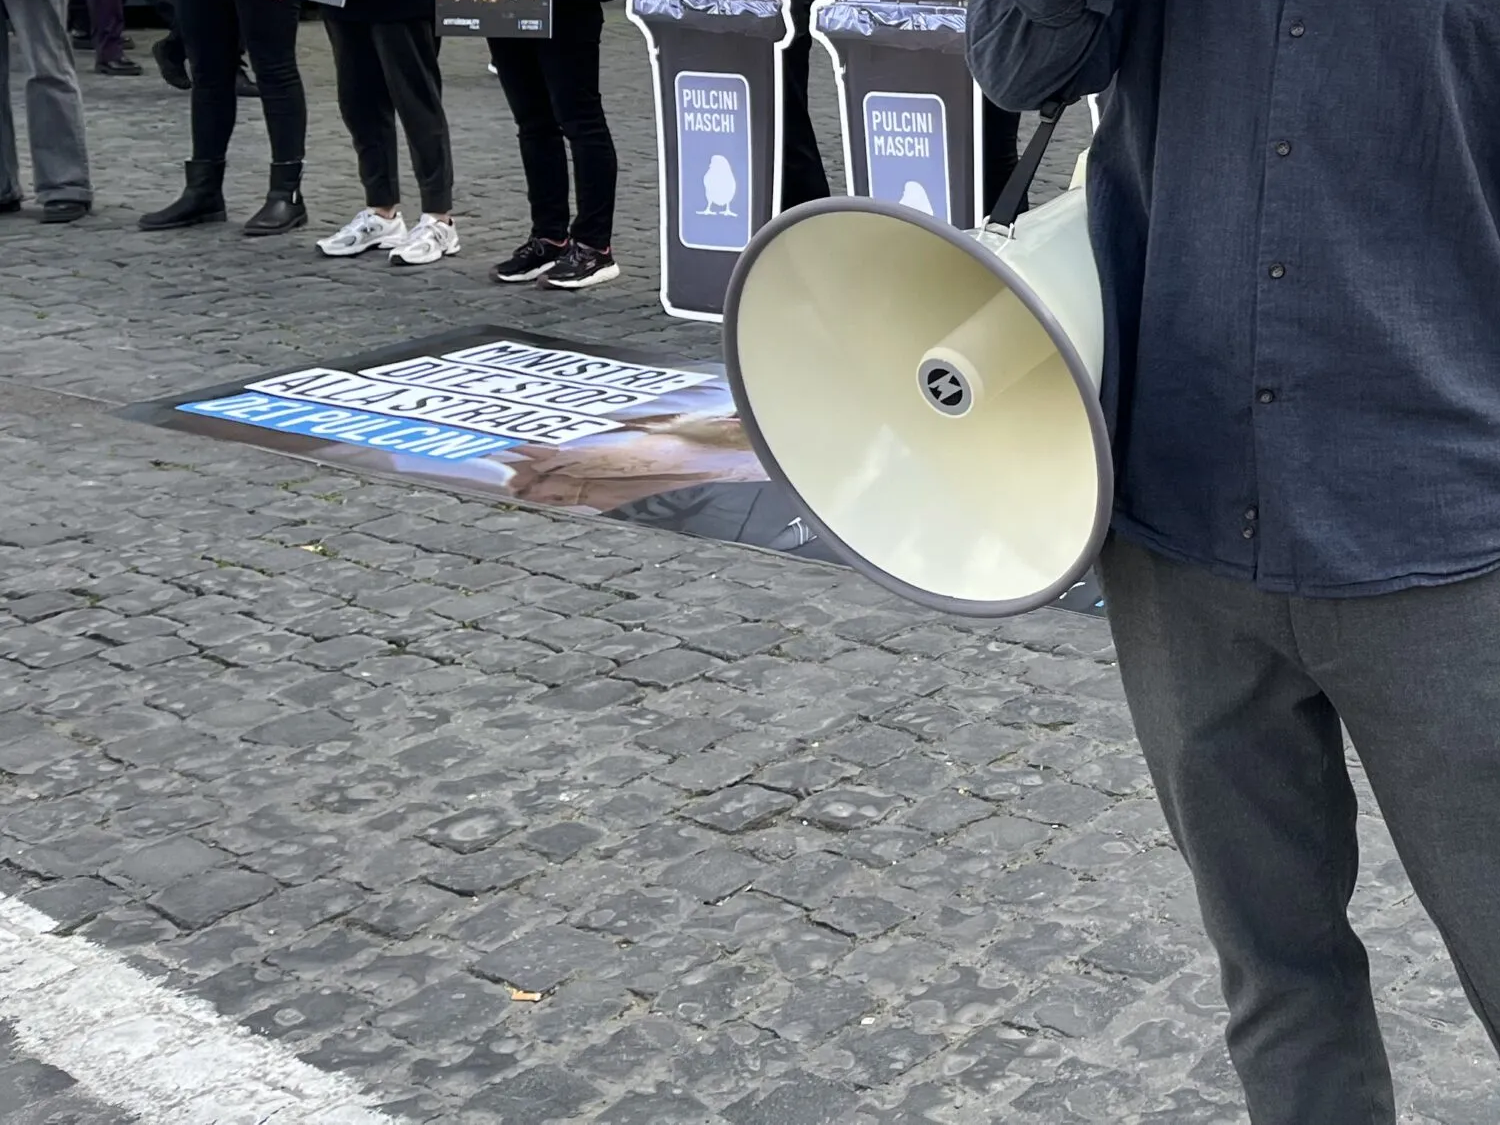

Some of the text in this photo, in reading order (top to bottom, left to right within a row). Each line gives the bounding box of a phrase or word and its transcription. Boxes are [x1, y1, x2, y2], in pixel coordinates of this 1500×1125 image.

[682, 89, 738, 110] PULCINI
[684, 112, 735, 133] MASCHI
[872, 110, 932, 133] PULCINI
[874, 135, 930, 158] MASCHI
[376, 361, 638, 408] DITE STOP
[263, 373, 605, 440] ALLA STRAGE
[194, 396, 509, 460] DEI PULCINI
